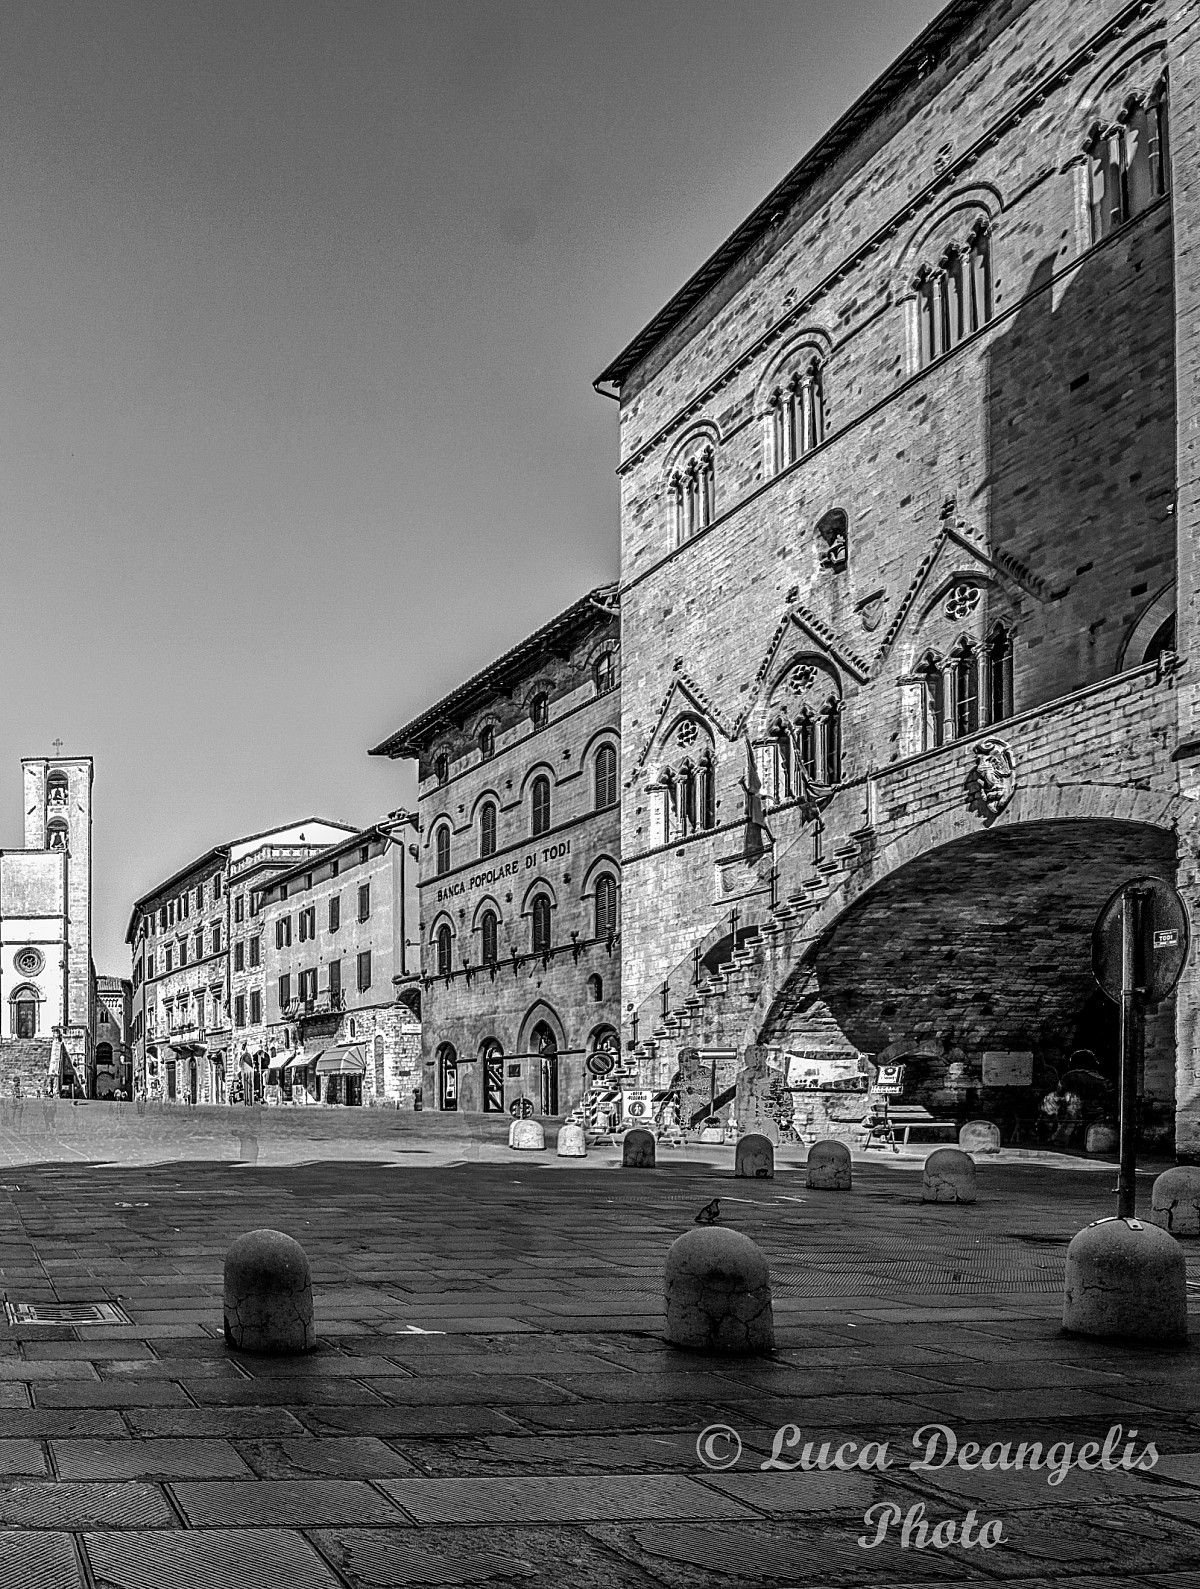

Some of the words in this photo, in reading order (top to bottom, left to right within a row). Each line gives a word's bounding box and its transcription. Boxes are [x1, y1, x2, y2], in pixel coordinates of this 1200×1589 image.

[437, 881, 466, 902] BANCA
[469, 860, 519, 890] POPOLARE
[525, 852, 537, 869] DI
[542, 839, 571, 862] TODI
